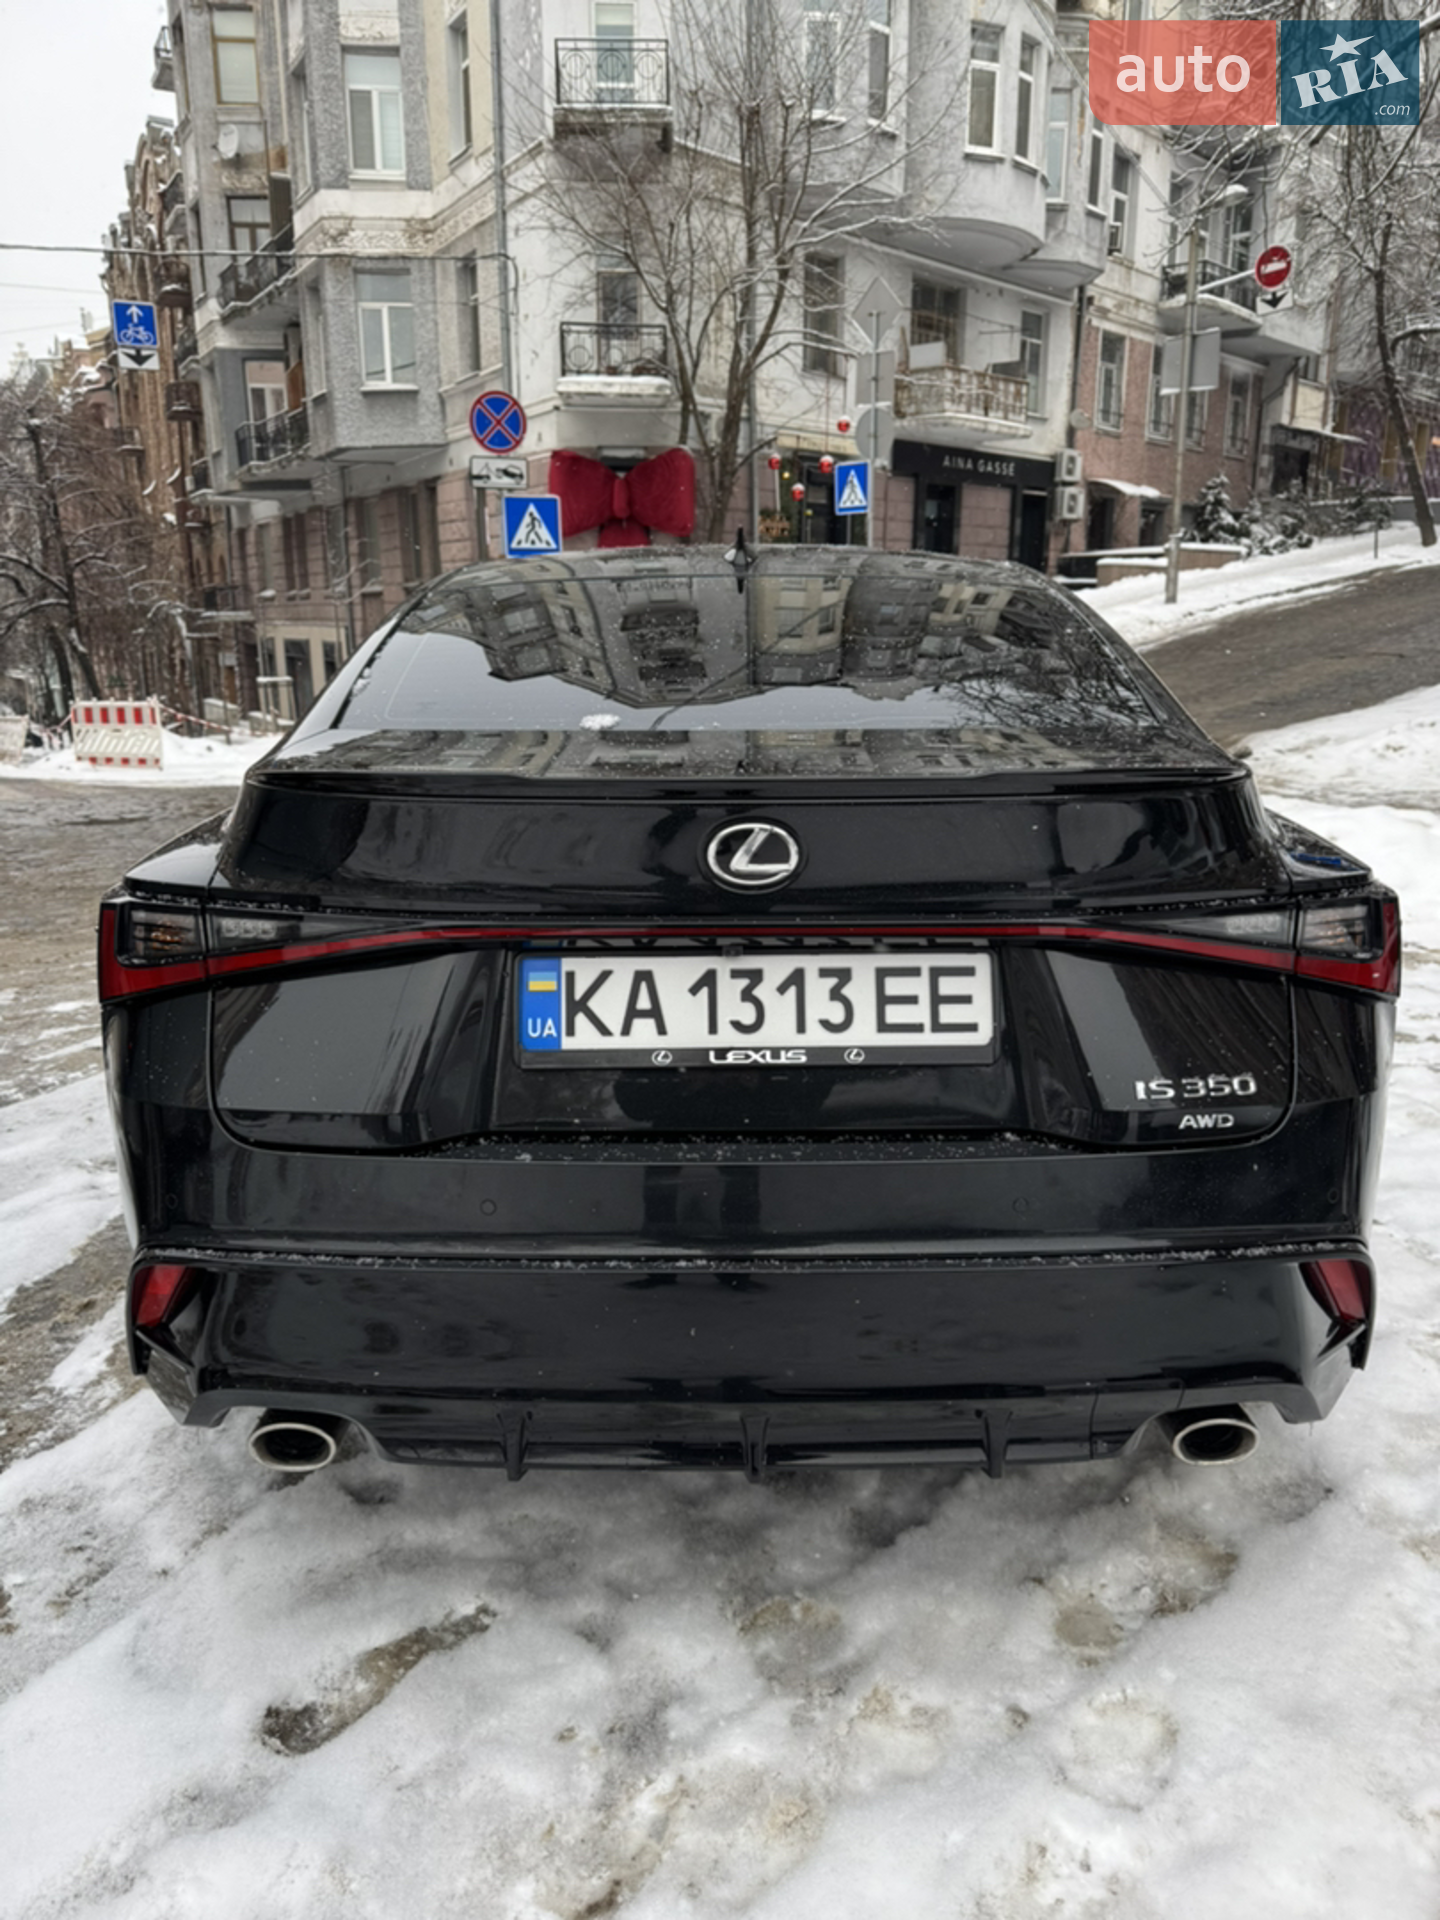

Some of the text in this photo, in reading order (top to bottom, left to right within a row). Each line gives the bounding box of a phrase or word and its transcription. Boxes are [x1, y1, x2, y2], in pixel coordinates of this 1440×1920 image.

[942, 454, 974, 471] AINA
[527, 966, 979, 1038] UA KA 1313 EE
[708, 1049, 808, 1064] LEXUS
[1135, 1075, 1257, 1100] IS 350
[1178, 1113, 1235, 1130] AWD
